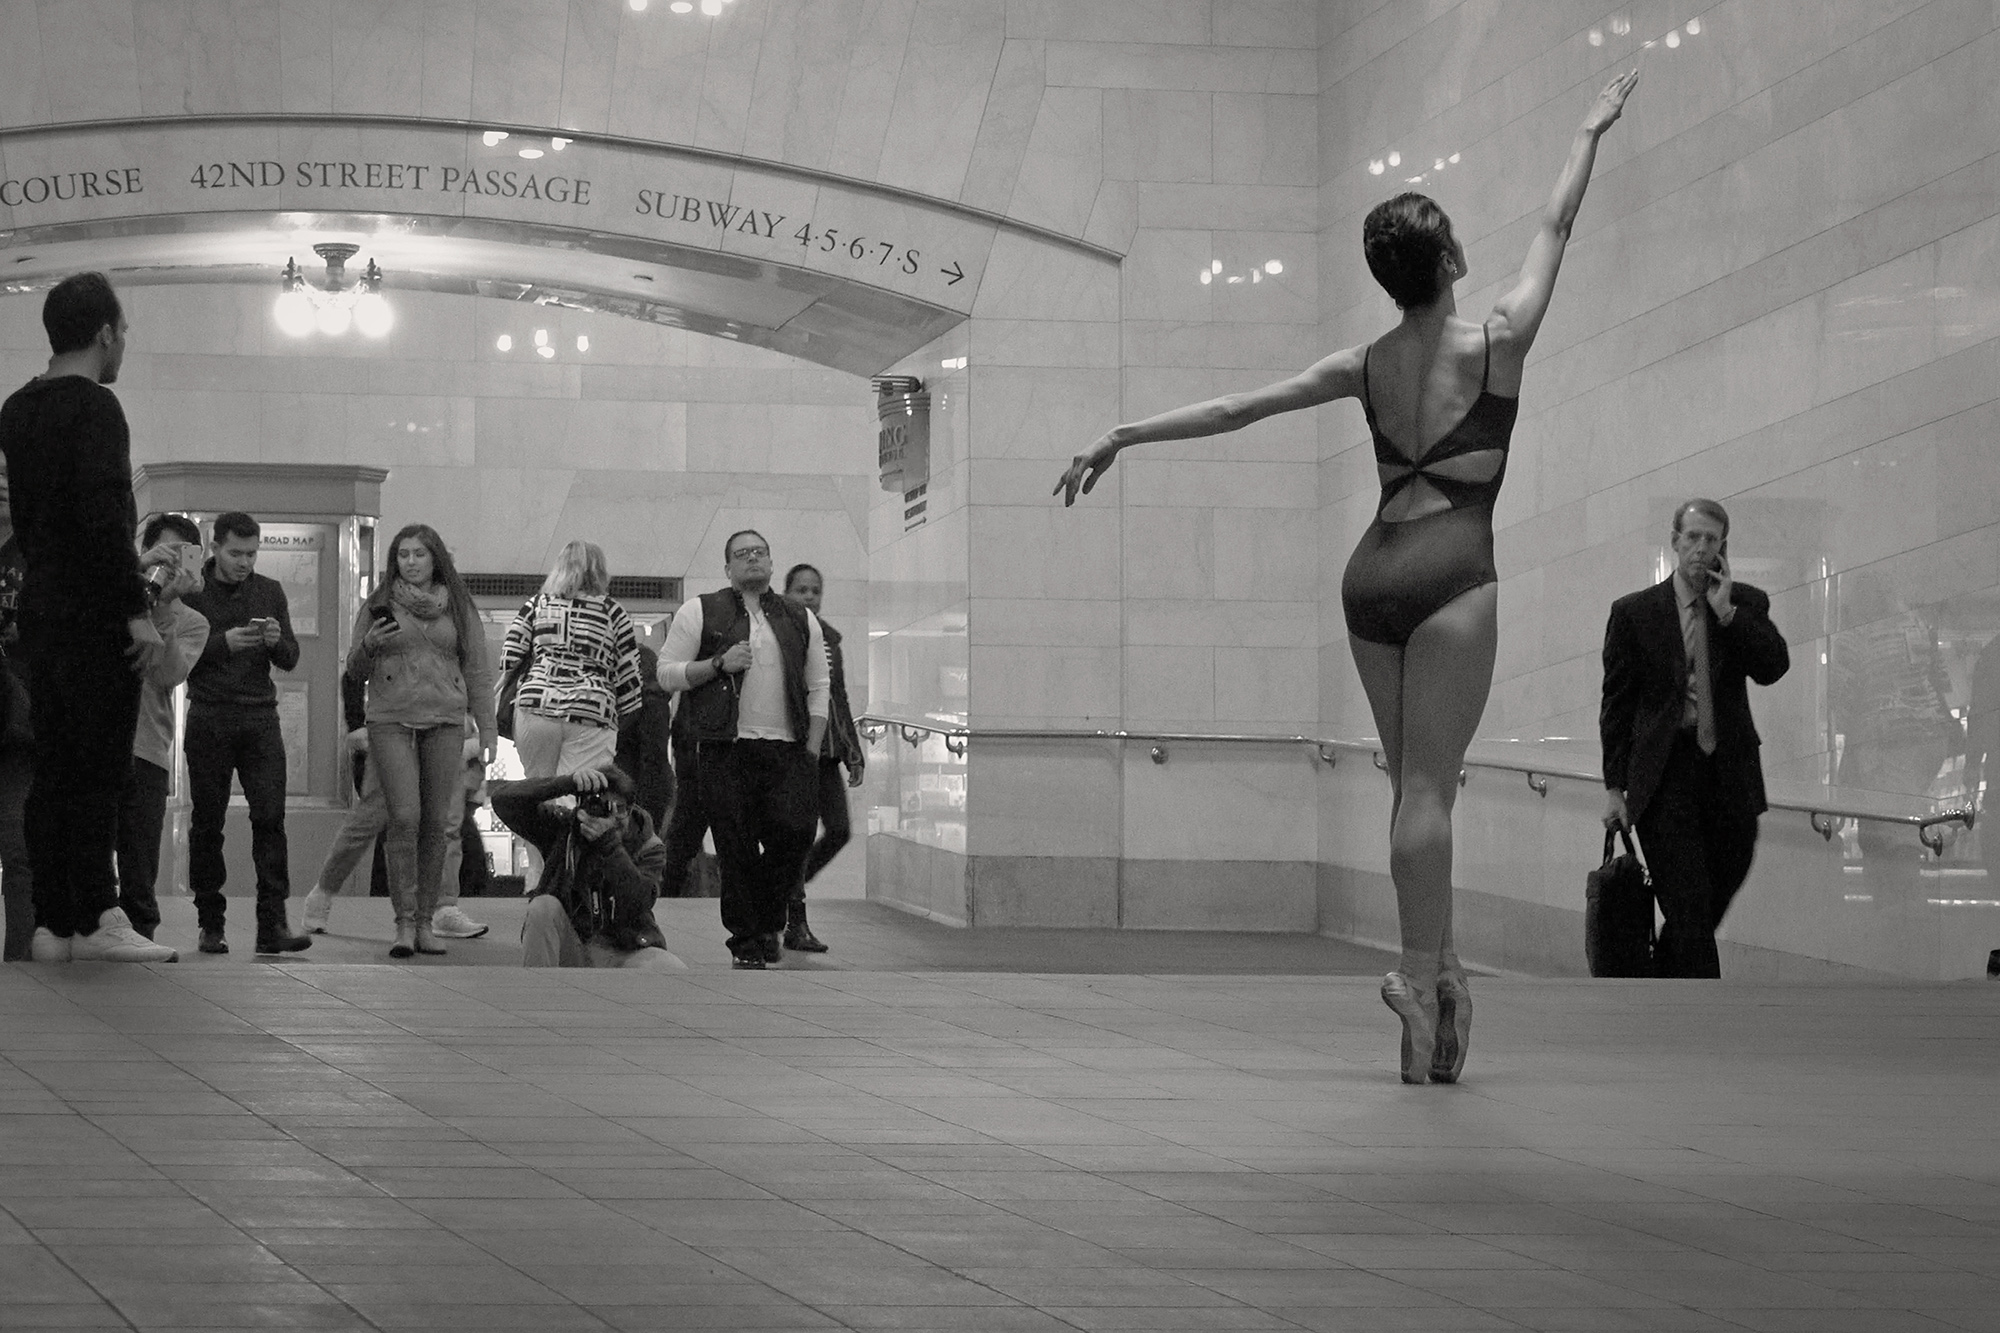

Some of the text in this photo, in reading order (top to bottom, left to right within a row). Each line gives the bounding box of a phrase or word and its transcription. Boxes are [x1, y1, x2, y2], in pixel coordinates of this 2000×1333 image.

[0, 168, 144, 206] COURSE
[190, 161, 285, 189] 42ND
[296, 161, 430, 190] STREET
[441, 166, 591, 206] PASSAGE
[635, 189, 786, 239] SUBWAY
[259, 536, 314, 546] ROAD MAP
